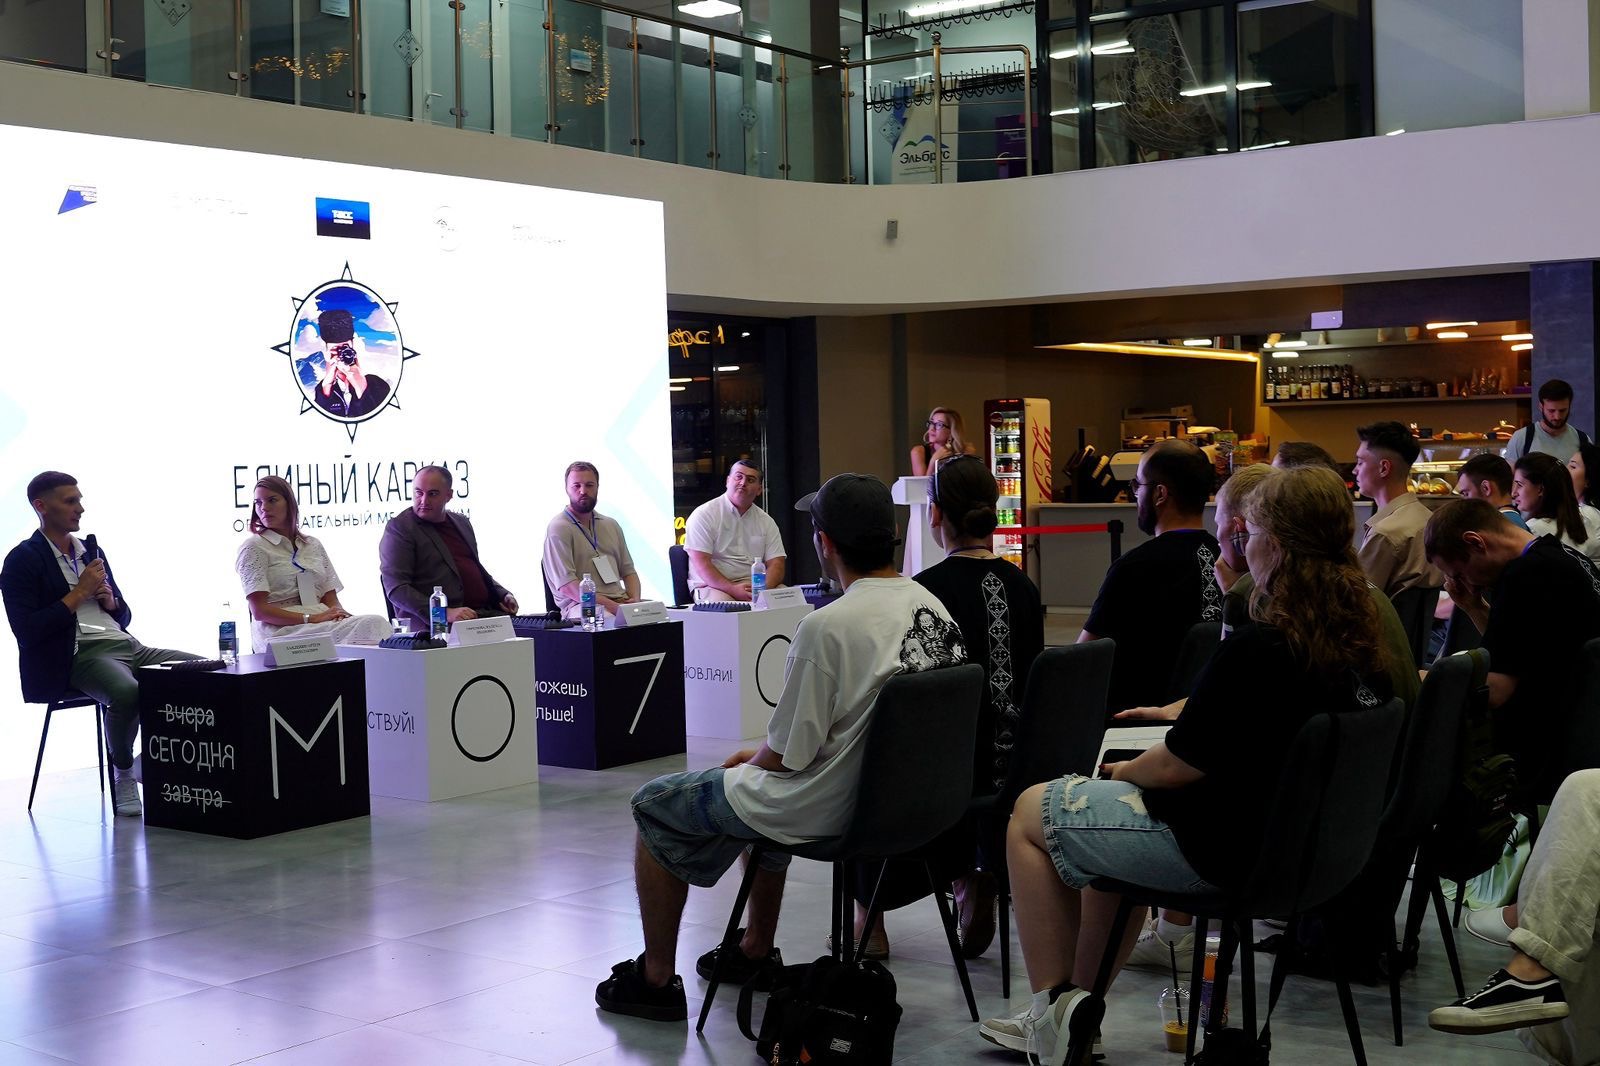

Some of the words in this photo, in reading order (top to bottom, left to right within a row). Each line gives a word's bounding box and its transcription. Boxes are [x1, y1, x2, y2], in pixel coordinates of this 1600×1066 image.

[900, 149, 951, 164] Эльбрс
[233, 454, 358, 509] ЕНЫЙ
[367, 459, 471, 503] КАВЗ
[233, 510, 373, 533] ОАТЕЛЬНЫЙ
[164, 703, 215, 732] вчера
[367, 711, 415, 734] СТВУЙ!
[149, 734, 236, 773] СЕГОДНЯ
[162, 783, 224, 813] завтра
